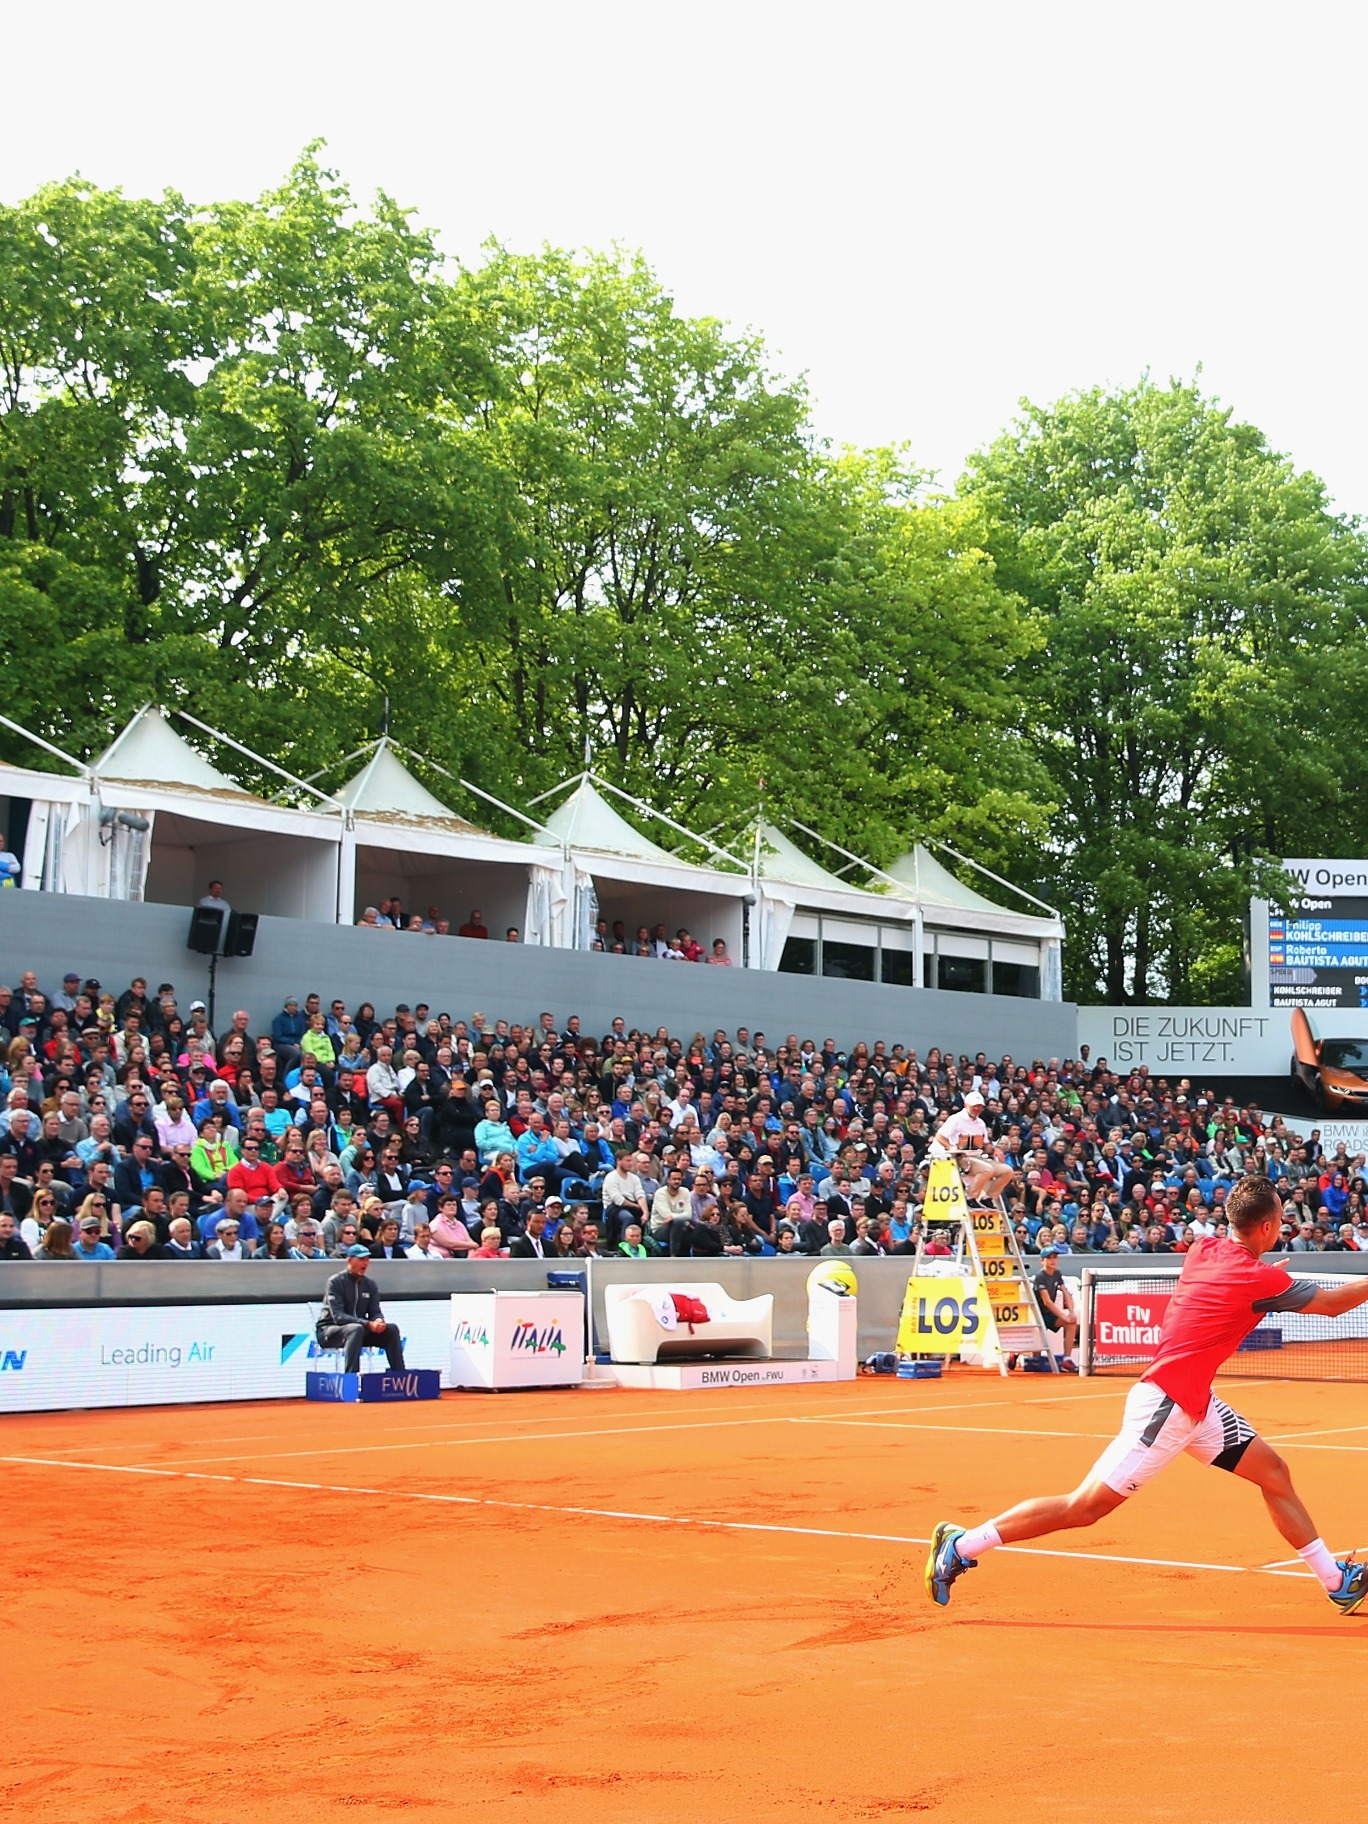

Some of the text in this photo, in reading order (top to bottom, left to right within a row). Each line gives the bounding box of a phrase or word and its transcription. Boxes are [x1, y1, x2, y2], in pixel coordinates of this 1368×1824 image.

[1315, 869, 1368, 889] Open
[1301, 897, 1332, 911] Open
[1286, 944, 1327, 955] Roberto
[1286, 956, 1339, 966] BAUTISTA
[1273, 986, 1342, 995] KOHLSCHREIBER
[1273, 998, 1314, 1007] BAUTISTA
[1113, 1017, 1270, 1038] DIE ZUKUNFT
[1113, 1041, 1235, 1062] IST JETZT.
[1323, 1124, 1359, 1137] BMW
[932, 1186, 959, 1202] LOS
[972, 1214, 995, 1230] LOS
[983, 1260, 1005, 1277] LOS
[918, 1296, 980, 1335] LOS
[996, 1306, 1019, 1323] LOS
[1127, 1305, 1151, 1324] Fly
[1100, 1321, 1162, 1345] Emirat
[101, 1342, 215, 1368] Leading Air
[382, 1373, 419, 1398] FWU
[702, 1370, 784, 1384] BMW Open FWU
